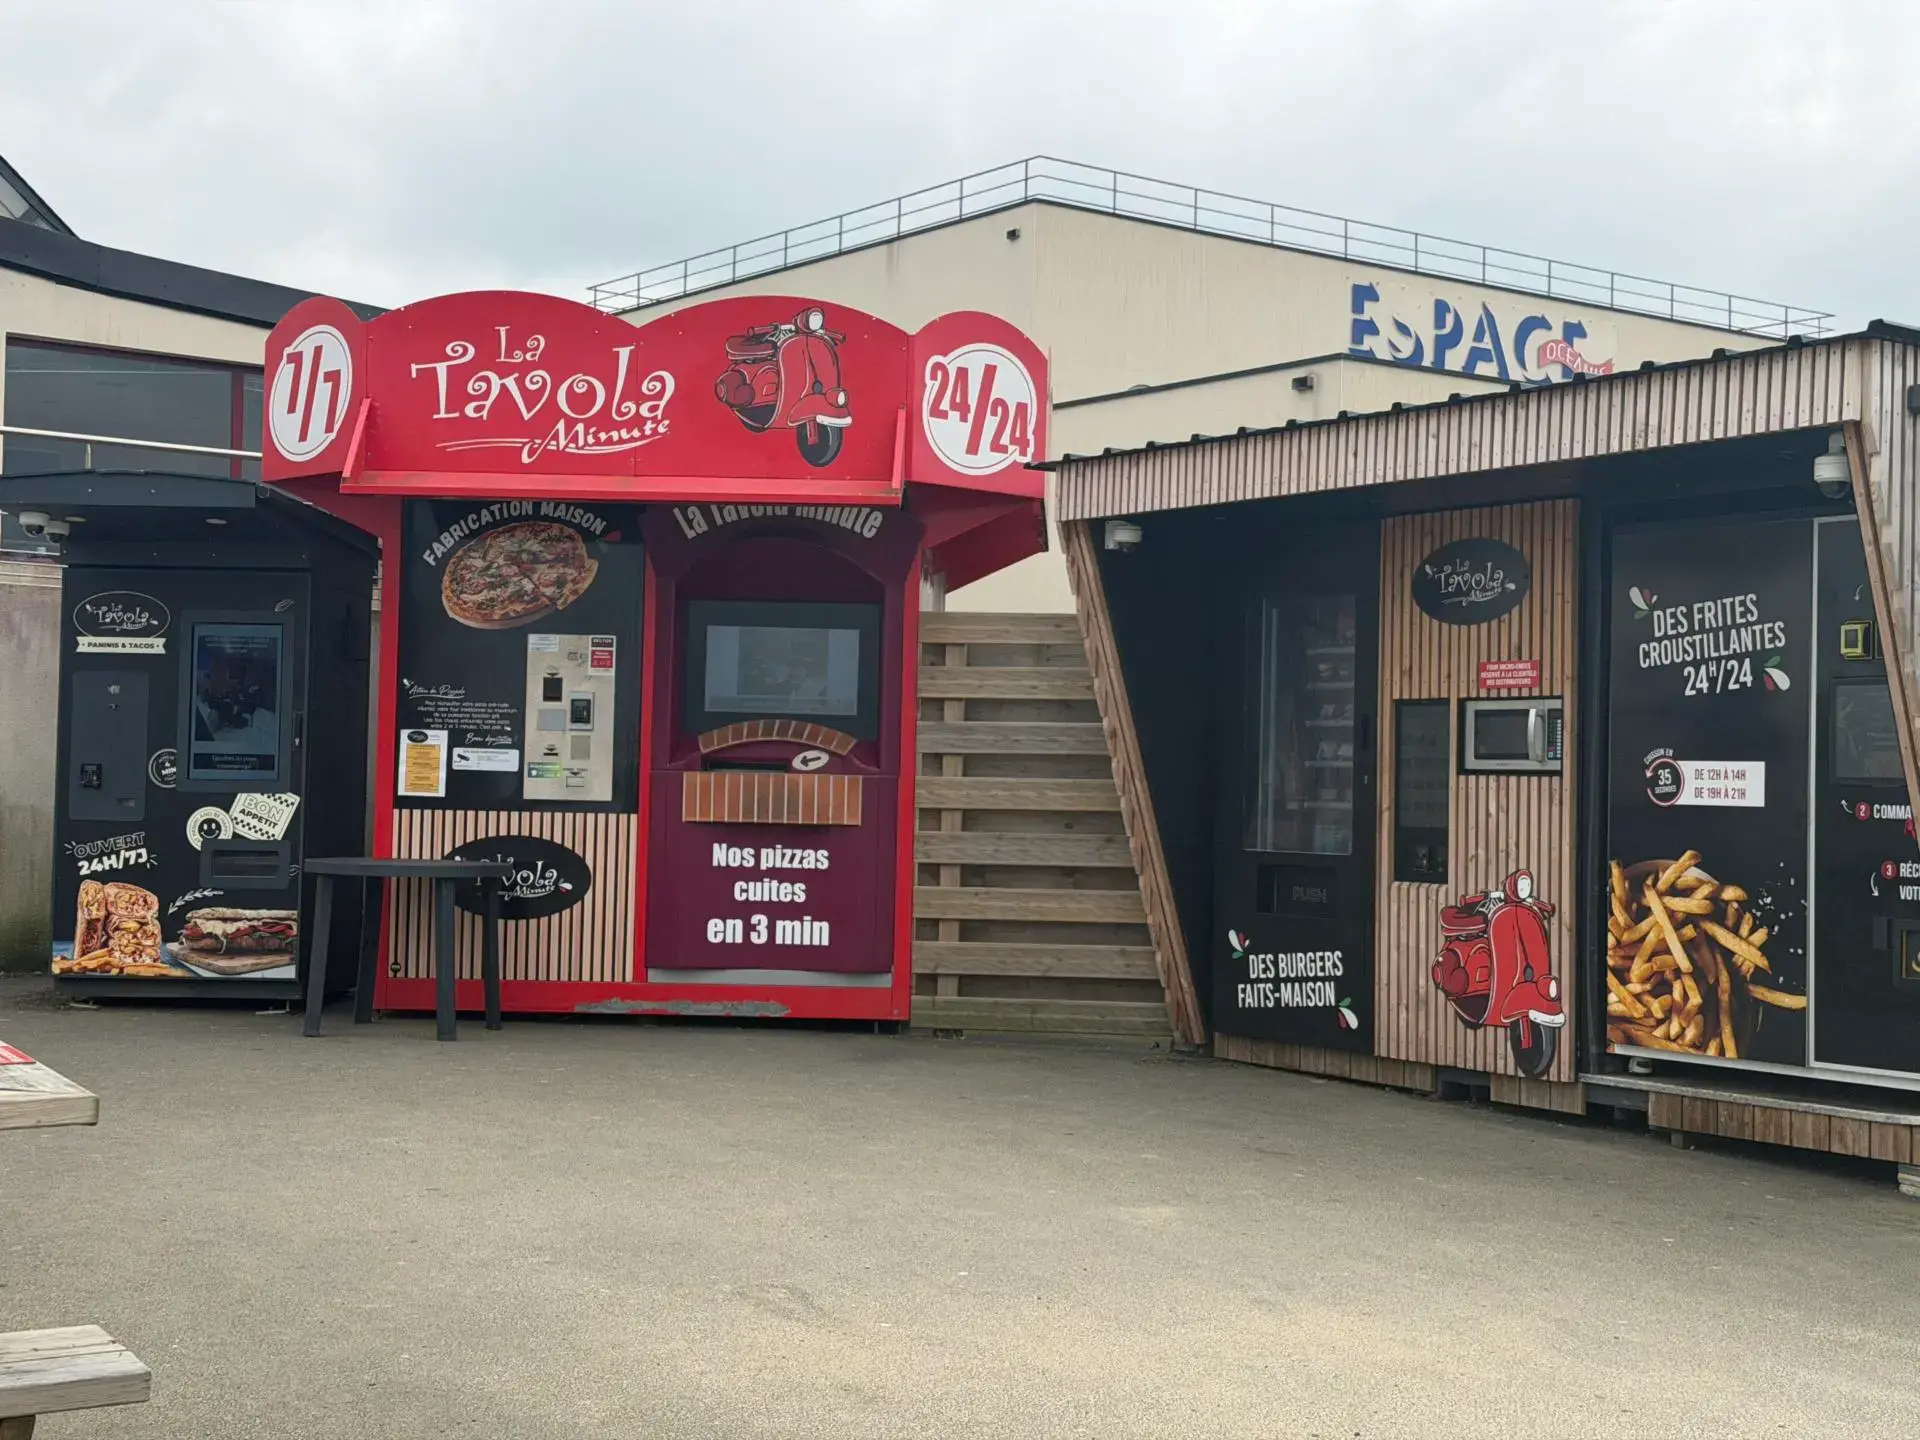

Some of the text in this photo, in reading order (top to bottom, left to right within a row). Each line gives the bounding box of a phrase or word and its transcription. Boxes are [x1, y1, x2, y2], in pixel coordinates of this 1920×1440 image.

[494, 326, 546, 363] La
[1349, 282, 1588, 384] ESPACE
[411, 341, 675, 422] Tavola
[929, 361, 1030, 457] 24/24
[521, 418, 671, 464] Minute
[423, 500, 607, 566] FABRICATION MAISON
[672, 504, 709, 540] La
[1434, 561, 1504, 593] Tavola
[1456, 558, 1470, 572] La
[93, 605, 150, 623] Tavola
[1653, 593, 1758, 637] DES FRITES
[87, 642, 120, 650] PANINIS
[128, 642, 155, 650] TACOS
[1639, 621, 1786, 669] CROUSTILLANTES
[1683, 657, 1753, 696] 24H/24
[1643, 748, 1674, 765] CUISSON EN
[1658, 769, 1672, 786] 35
[1694, 766, 1746, 781] DE 12H À 14H
[1654, 785, 1677, 794] SECONDES
[1694, 784, 1746, 800] DE 19H À 21H
[239, 807, 279, 829] APPETIT
[243, 795, 283, 821] BON
[1859, 803, 1912, 820] 2 COMMA
[73, 831, 146, 858] OUVERT
[712, 843, 829, 870] Nos pizzas
[77, 847, 148, 876] 24H/7J
[1886, 860, 1920, 878] 3 RÉC
[733, 878, 806, 903] cuites
[707, 914, 829, 946] en 3 min
[1249, 950, 1343, 979] DES BURGERS
[1237, 981, 1336, 1008] FAITS-MAISON
